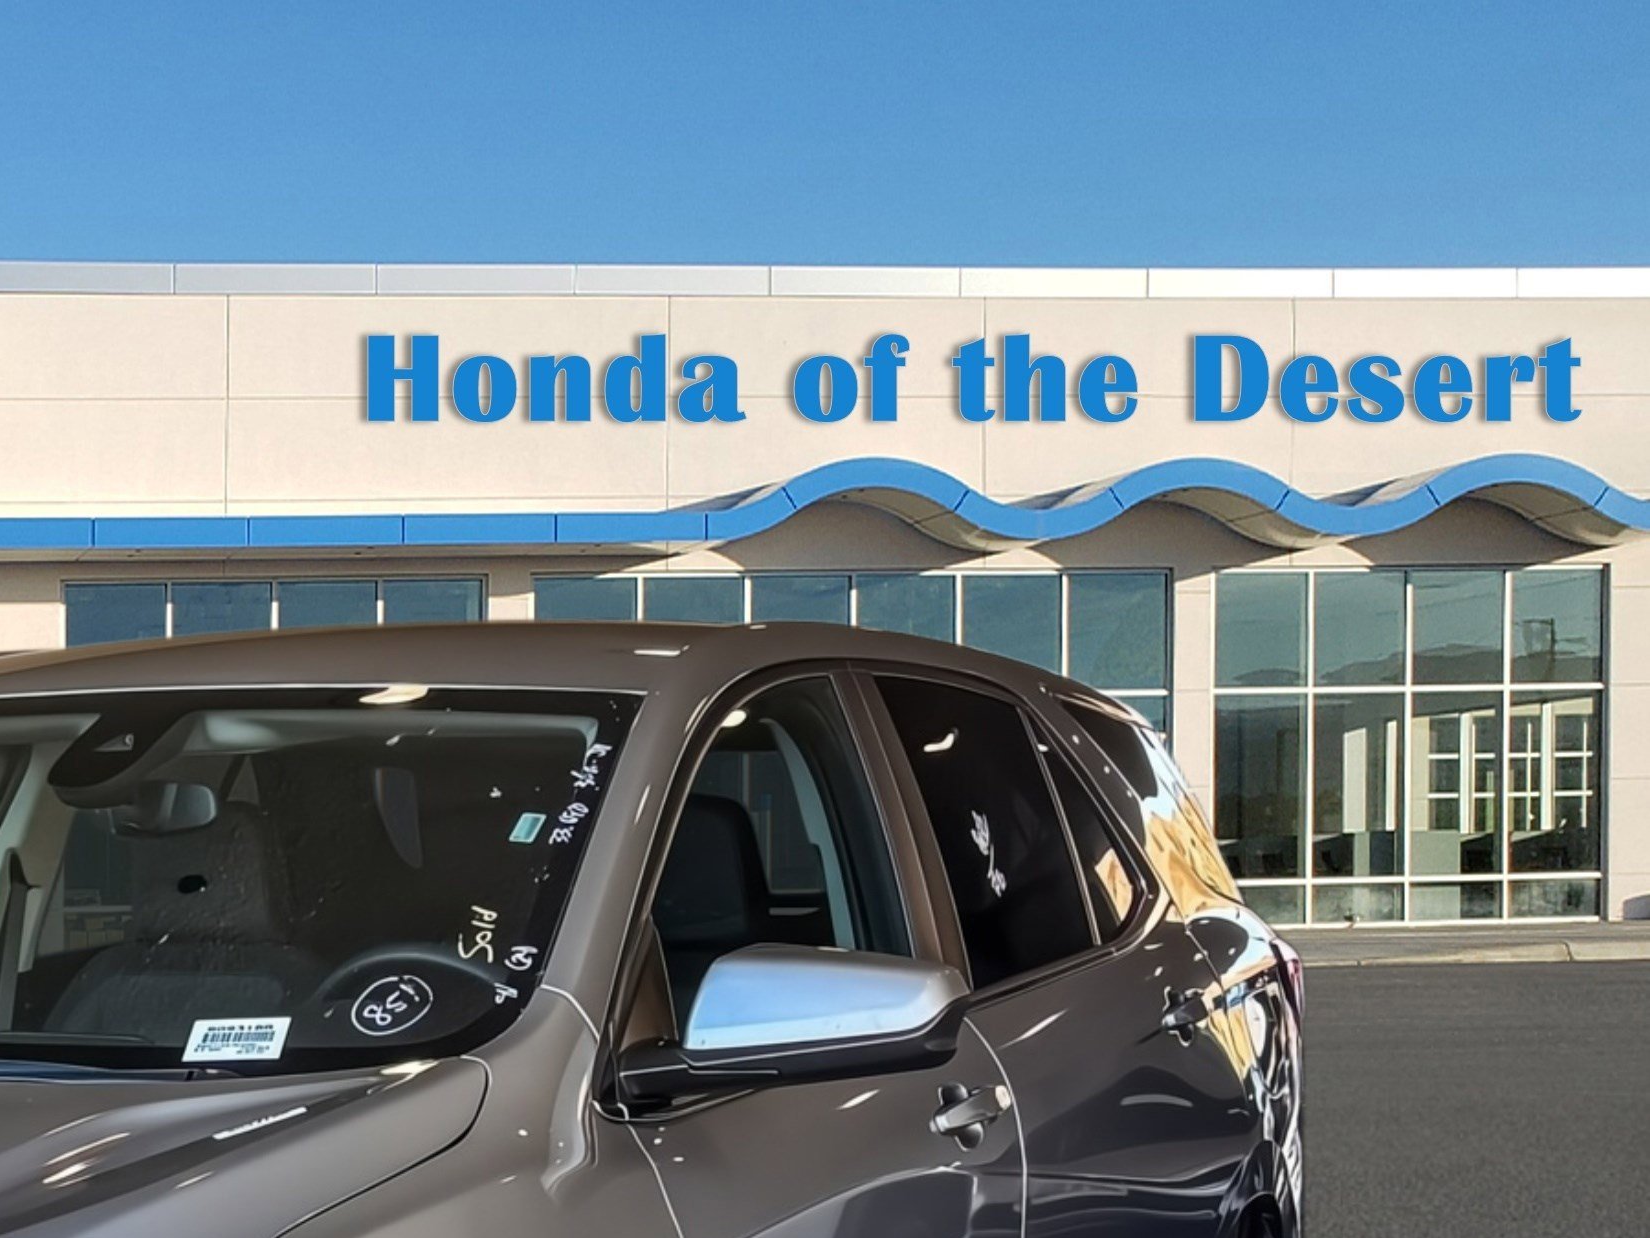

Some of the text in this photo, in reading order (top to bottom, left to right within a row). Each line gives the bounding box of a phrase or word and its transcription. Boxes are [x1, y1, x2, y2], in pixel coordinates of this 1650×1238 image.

[366, 333, 1584, 424] Honda of the Desert
[457, 904, 498, 964] Sold
